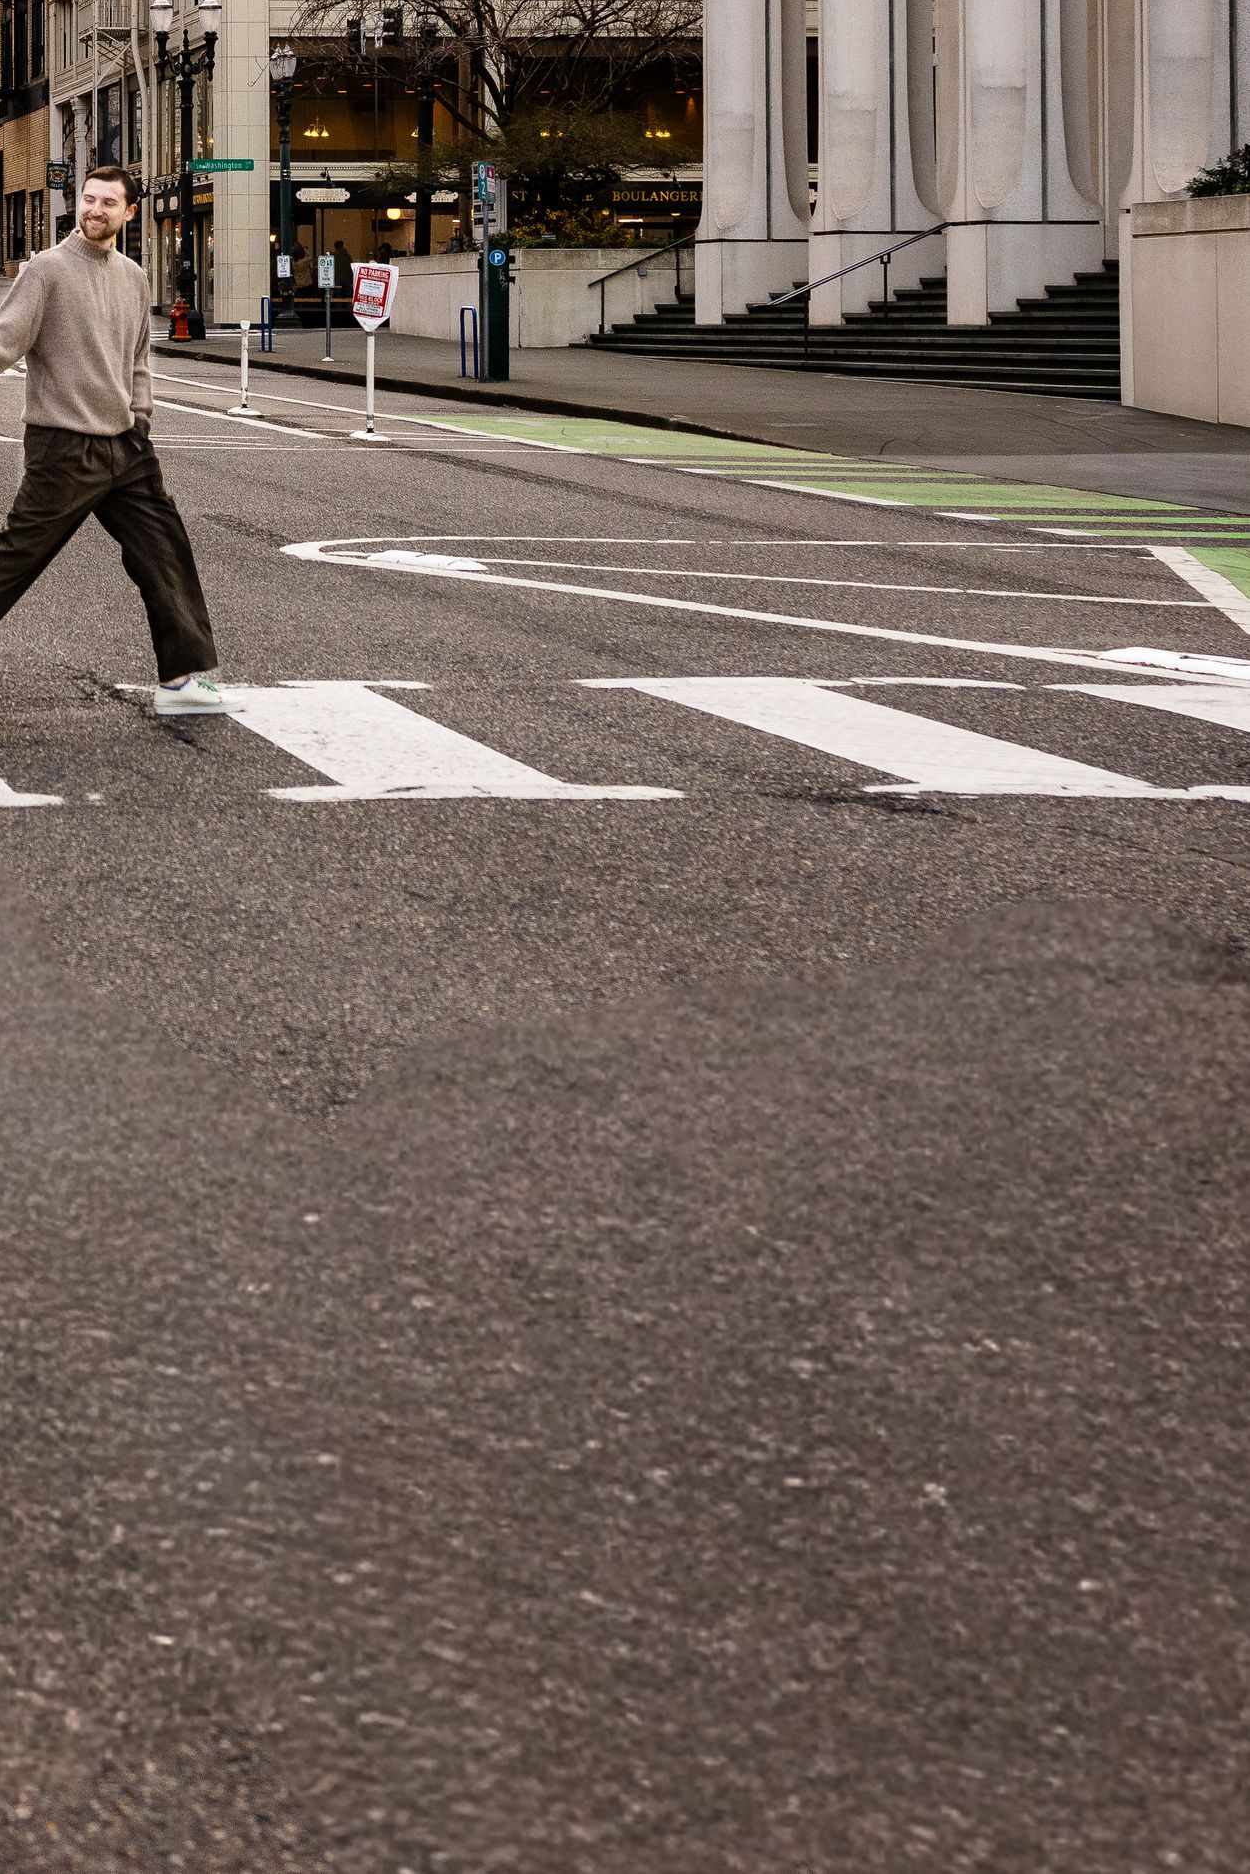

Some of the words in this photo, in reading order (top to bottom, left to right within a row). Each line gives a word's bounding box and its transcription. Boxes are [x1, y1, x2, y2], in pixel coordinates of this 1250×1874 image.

[205, 161, 243, 170] Washington
[511, 190, 528, 202] ST
[360, 267, 368, 276] NO
[368, 268, 389, 279] PARKING
